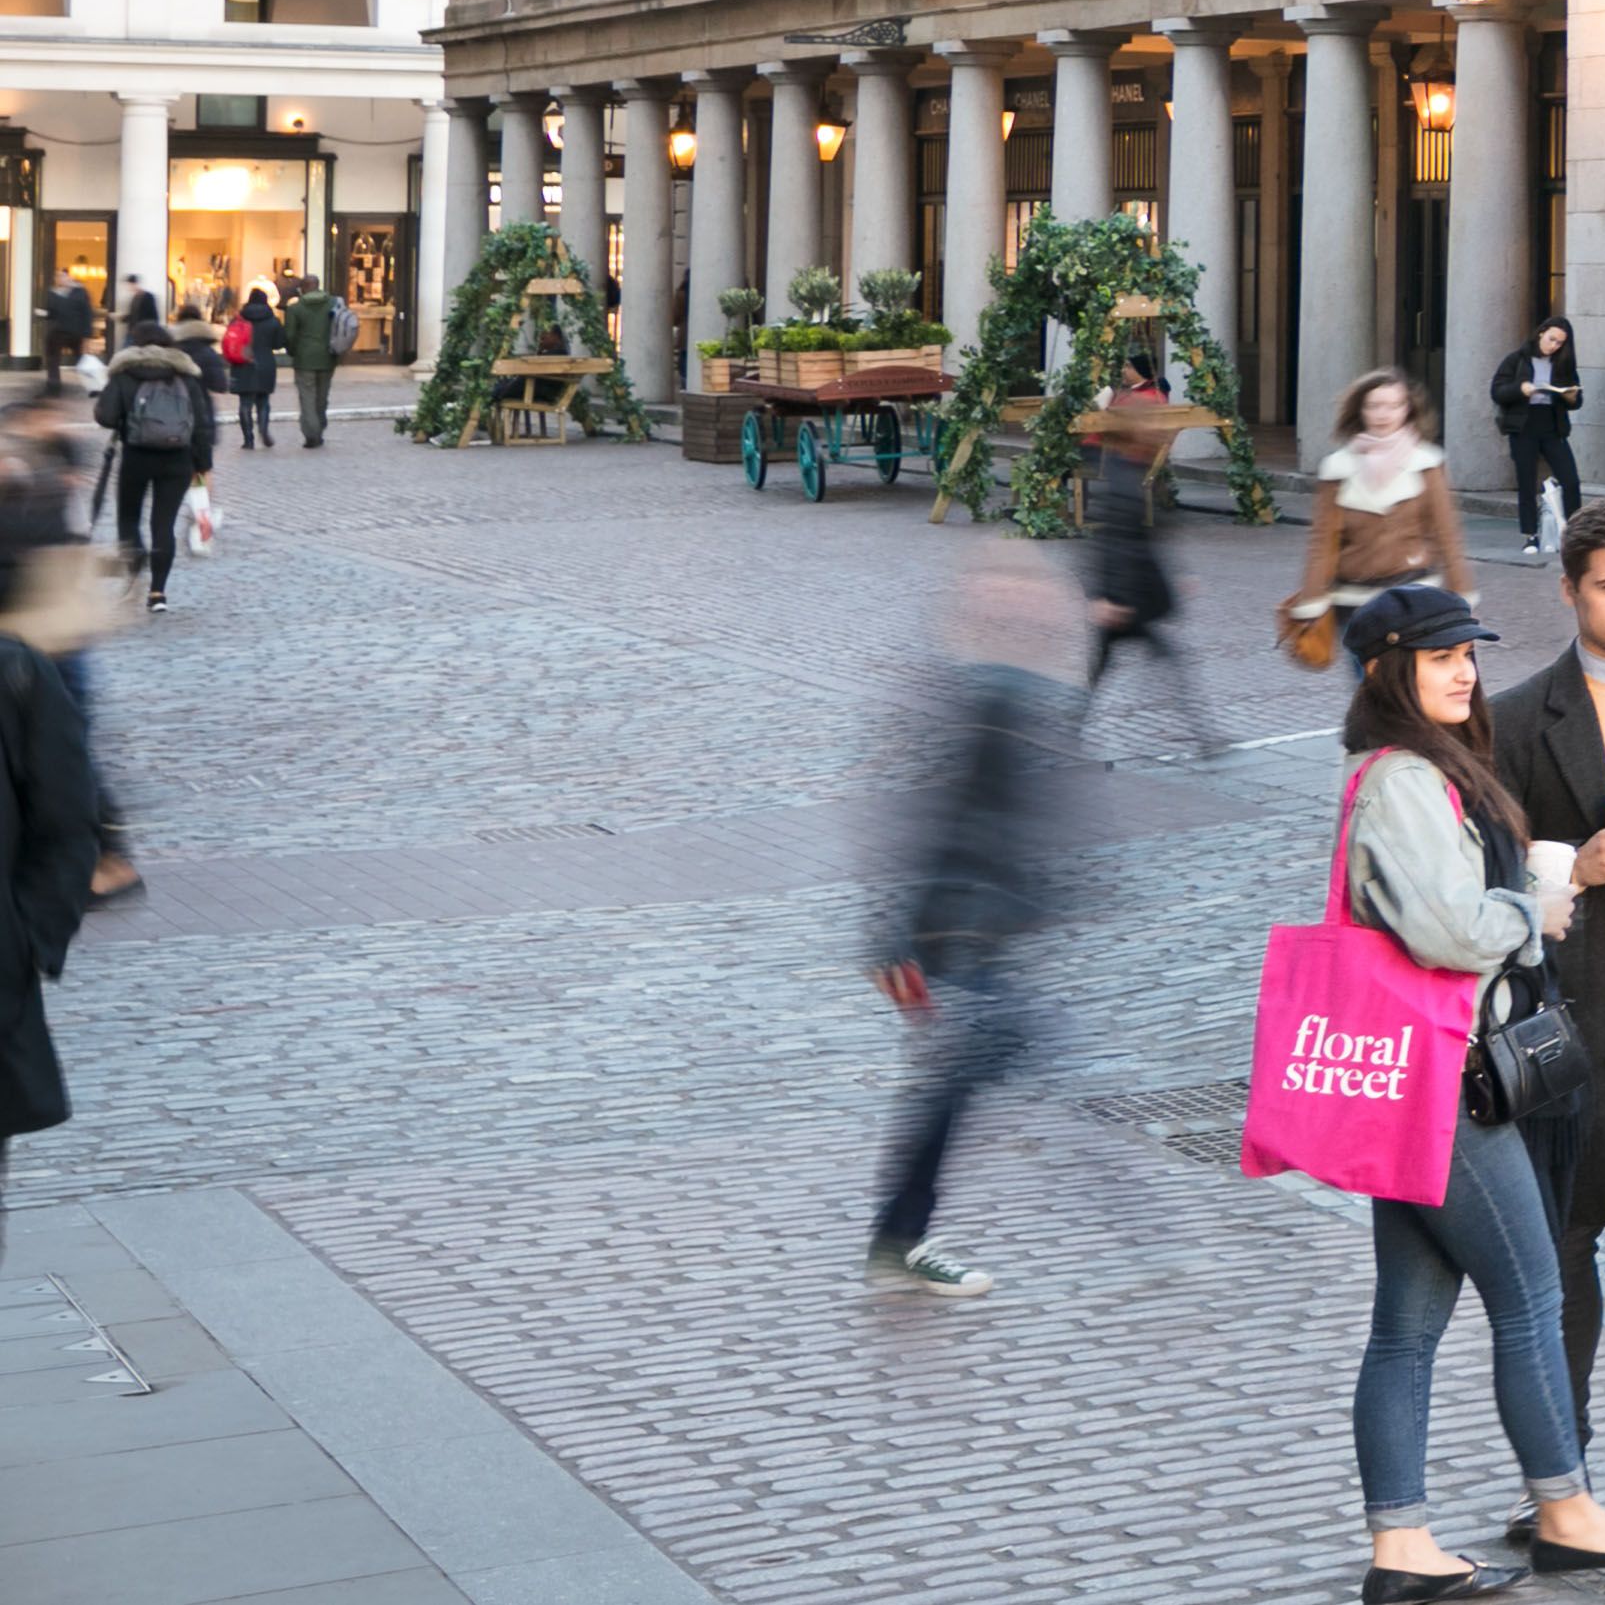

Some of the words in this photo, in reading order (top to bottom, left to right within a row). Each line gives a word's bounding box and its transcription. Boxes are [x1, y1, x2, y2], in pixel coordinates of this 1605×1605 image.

[1111, 84, 1145, 102] HANEL
[1291, 1014, 1413, 1067] floral
[1282, 1060, 1408, 1100] street
